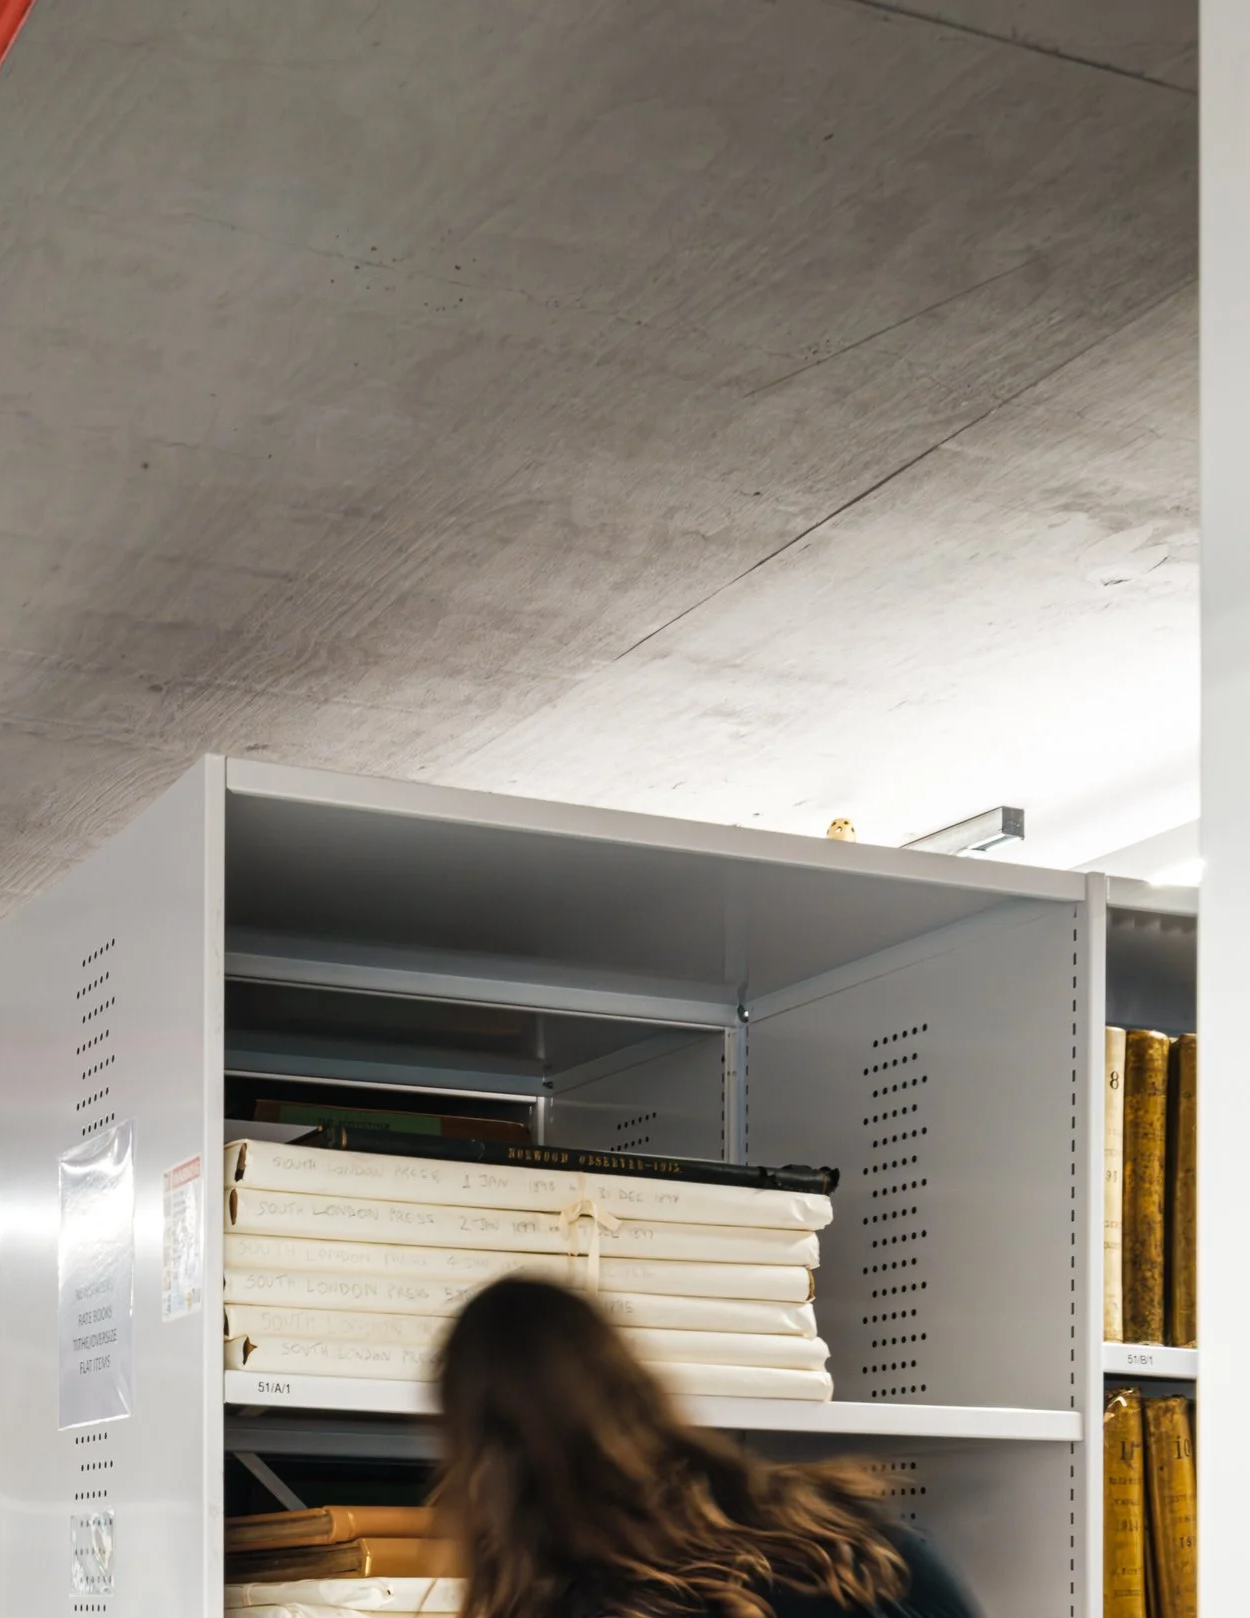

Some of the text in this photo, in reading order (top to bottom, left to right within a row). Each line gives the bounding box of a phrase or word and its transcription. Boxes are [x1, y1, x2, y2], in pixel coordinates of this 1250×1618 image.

[1109, 1070, 1120, 1090] 8
[272, 1155, 317, 1171] SOUTH
[327, 1164, 385, 1179] LONDON
[477, 1174, 510, 1190] JAN
[618, 1187, 645, 1204] DEC
[257, 1201, 304, 1217] SOUTH
[312, 1204, 380, 1223] LONDON
[388, 1208, 436, 1225] PRESS
[243, 1273, 297, 1290] SOUTH
[305, 1280, 379, 1299] LONDON
[280, 1342, 329, 1357] SOUTH
[257, 1381, 292, 1395] 51/A/1
